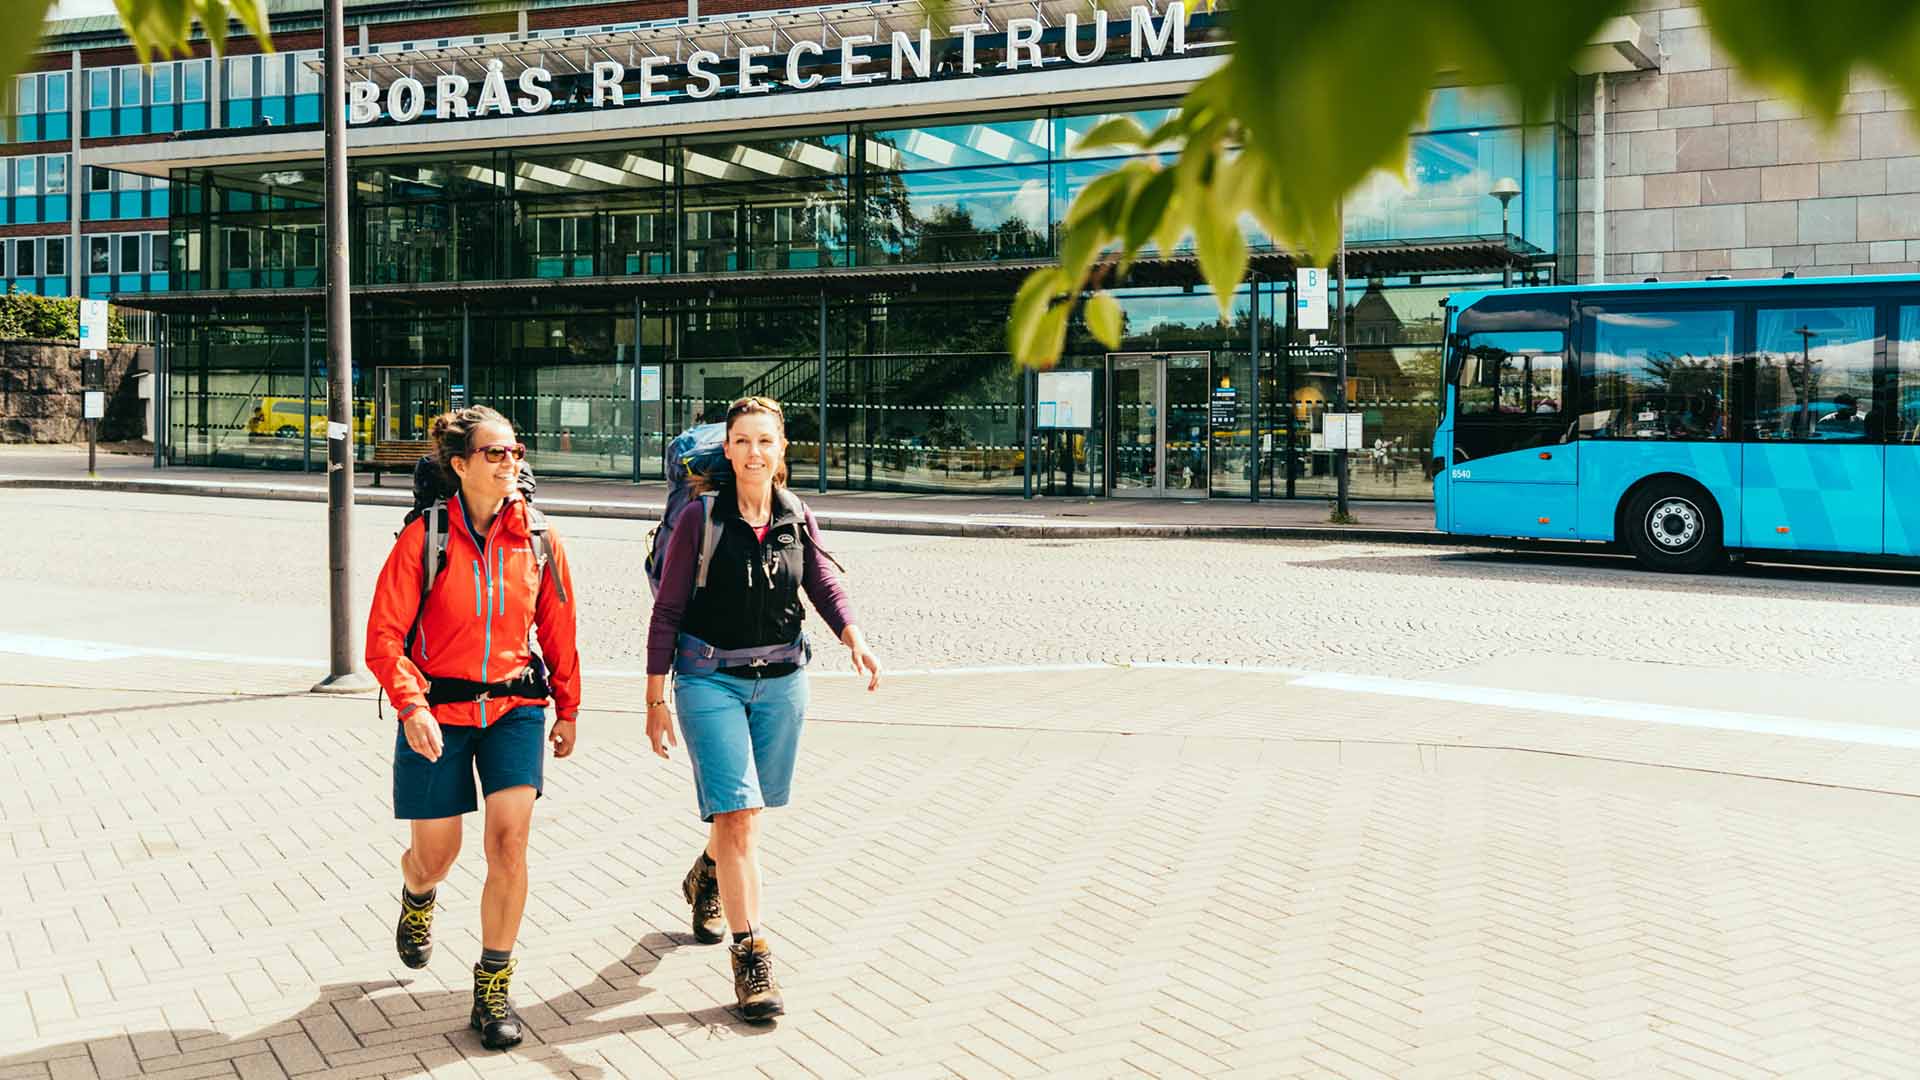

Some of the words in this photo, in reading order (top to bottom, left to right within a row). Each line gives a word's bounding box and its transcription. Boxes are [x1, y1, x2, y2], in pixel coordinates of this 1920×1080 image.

[349, 58, 553, 124] BORÅS
[593, 1, 1185, 106] RESECENTRUM
[1309, 270, 1317, 287] B
